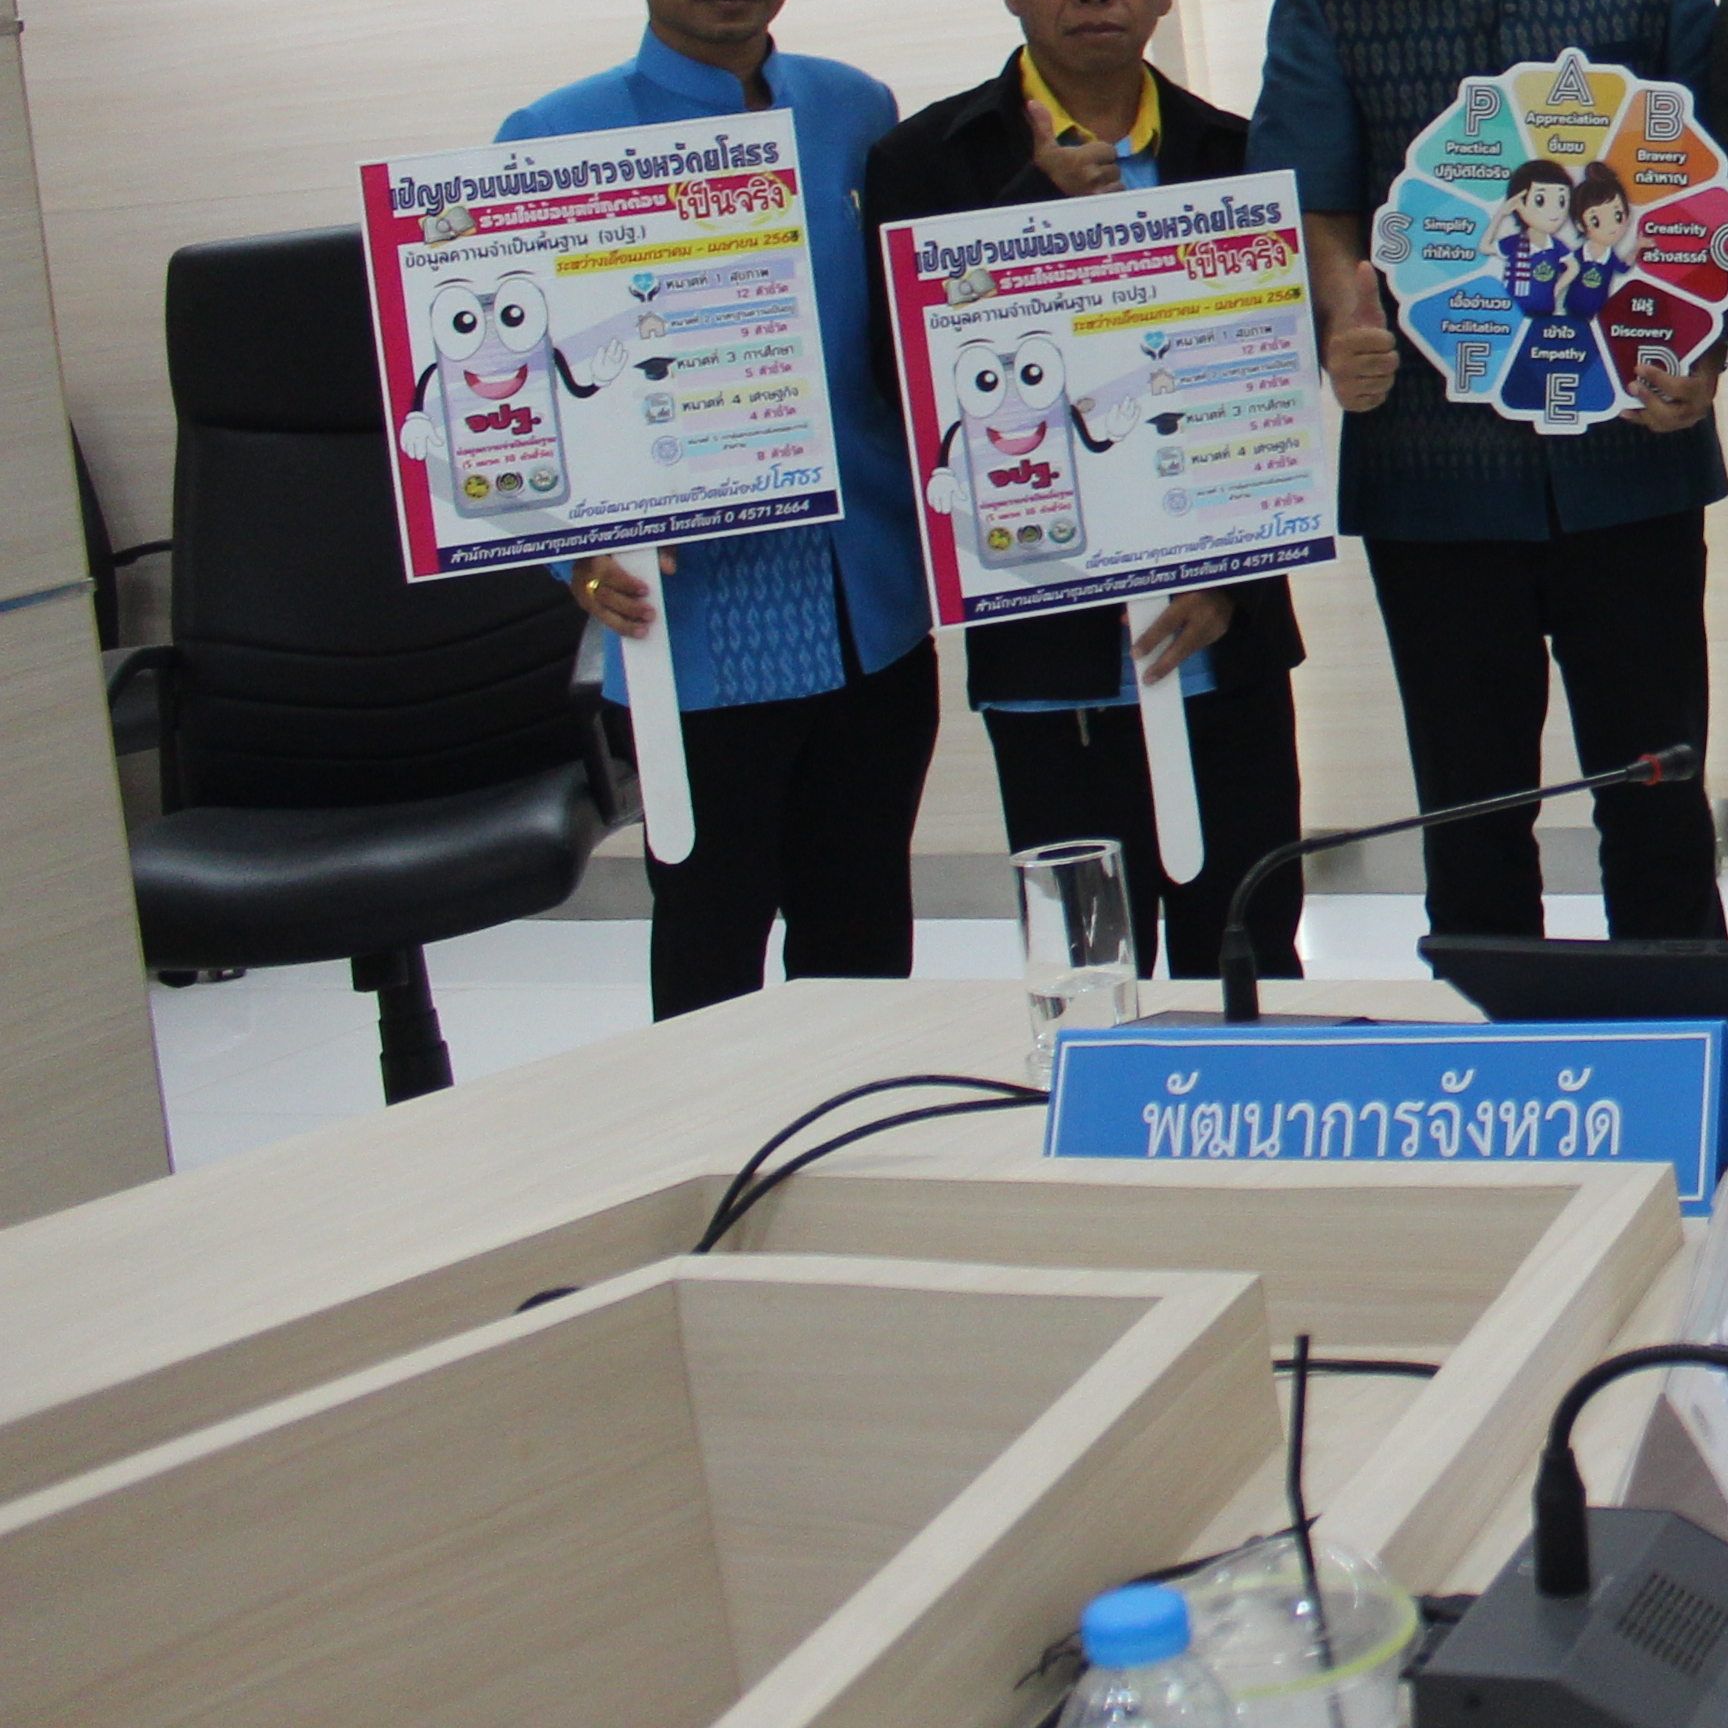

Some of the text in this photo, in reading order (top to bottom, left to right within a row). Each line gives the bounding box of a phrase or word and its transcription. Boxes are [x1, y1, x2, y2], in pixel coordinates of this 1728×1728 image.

[1547, 55, 1595, 106] A
[1465, 85, 1499, 136] P
[1525, 111, 1610, 128] Appreciation
[1645, 90, 1685, 142] B
[1446, 141, 1502, 156] Practical
[1548, 134, 1585, 153] ชื่นชม
[1637, 149, 1687, 166] Bravery
[390, 135, 779, 215] เชิญชวนพี่น้องชาวจังหวัดยโสธร
[1435, 162, 1511, 184] ปฏิบัติได้จริง
[1635, 167, 1688, 186] กล้าหาญ
[676, 176, 785, 221] เป็นจริง
[916, 196, 1282, 279] เชิญชวนพี่น้องชาวจังหวัดยโสธร
[1377, 211, 1412, 264] S
[1422, 218, 1476, 235] Simplify
[1644, 221, 1707, 239] Creativity
[405, 225, 646, 272] ข้อมูลความจำเป็นพื้นฐาน (จปฐ.)
[1184, 235, 1287, 282] เป็นจริง
[1422, 242, 1476, 261] ทำให้ง่าย
[1642, 244, 1708, 264] สร้างสรรค์
[930, 285, 1158, 334] ข้อมูลความจำเป็นพื้นฐาน (จปฐ.)
[1449, 290, 1512, 311] เอื้ออำนวย
[1441, 321, 1510, 335] Facilitation
[1543, 324, 1576, 339] เข้าใจ
[1610, 325, 1673, 341] Discovery
[1531, 345, 1587, 363] Empathy
[1455, 342, 1491, 394] F
[1545, 373, 1579, 424] E
[725, 509, 736, 523] 0
[738, 504, 772, 521] 4571
[775, 499, 811, 515] 2664
[1230, 559, 1240, 572] 0
[1242, 553, 1275, 569] 4571
[1277, 546, 1310, 564] 2664
[1142, 1066, 1623, 1158] พัฒนาการจังหวัด
